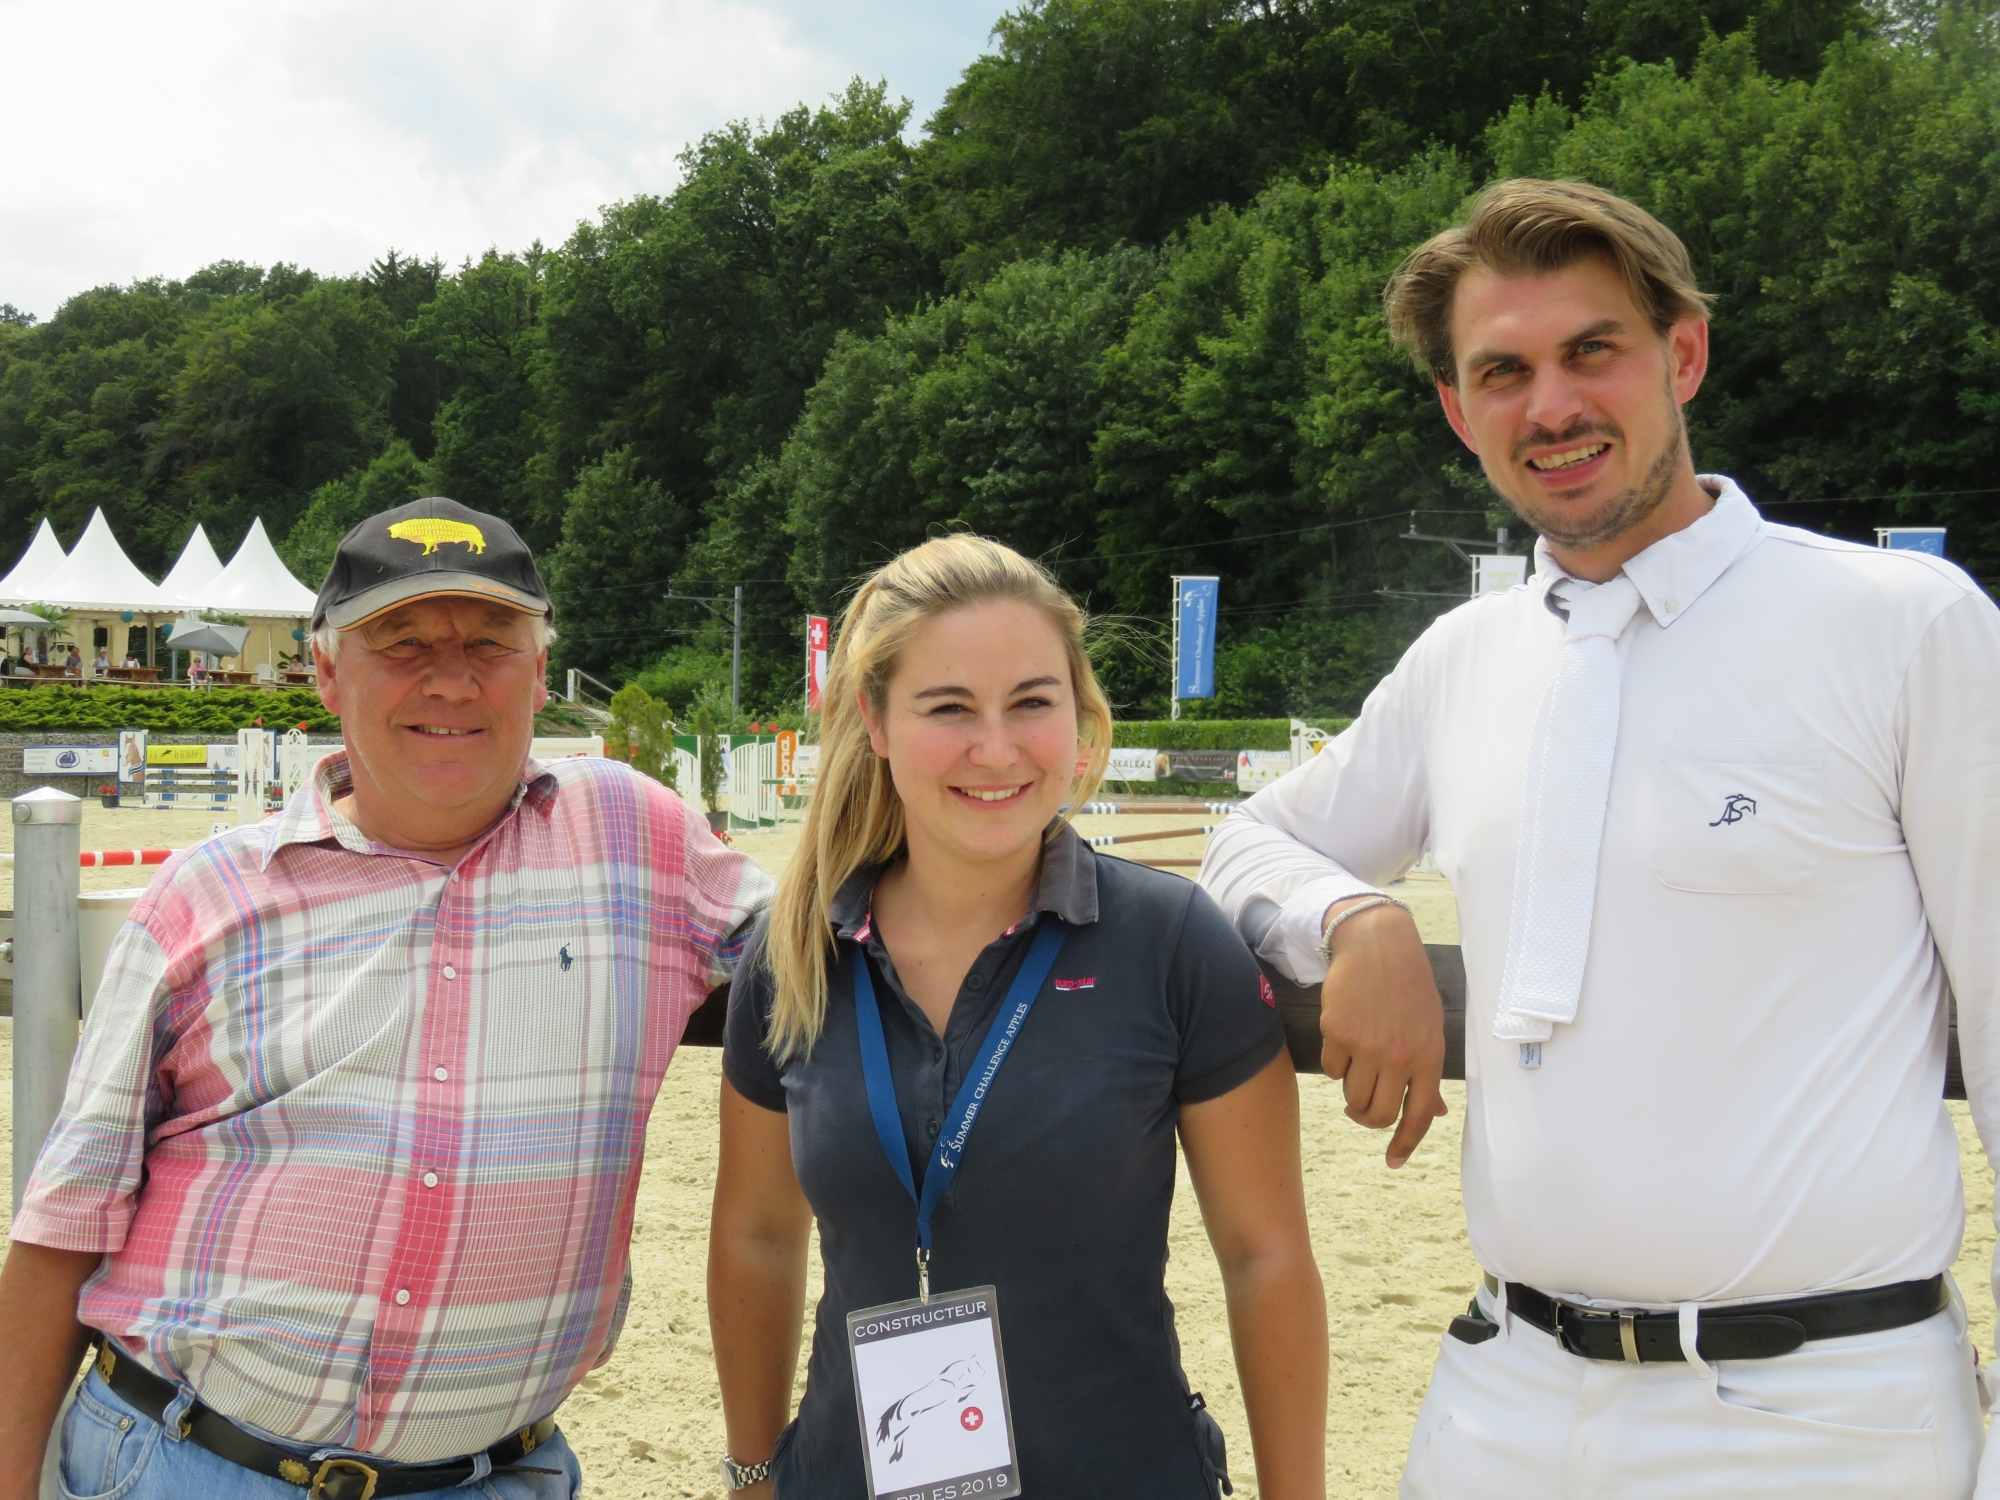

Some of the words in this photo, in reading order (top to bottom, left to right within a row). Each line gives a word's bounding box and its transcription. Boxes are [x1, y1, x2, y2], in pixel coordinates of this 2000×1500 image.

[174, 749, 203, 759] bühler
[1112, 759, 1152, 769] SKALKAZ
[1054, 977, 1096, 988] euro-star
[950, 1102, 979, 1153] SUMMER
[974, 1038, 1010, 1100] CHALLENGE
[1006, 1002, 1029, 1038] APPLES
[854, 1300, 987, 1338] CONSTRUCTEUR
[961, 1473, 1008, 1497] 2019
